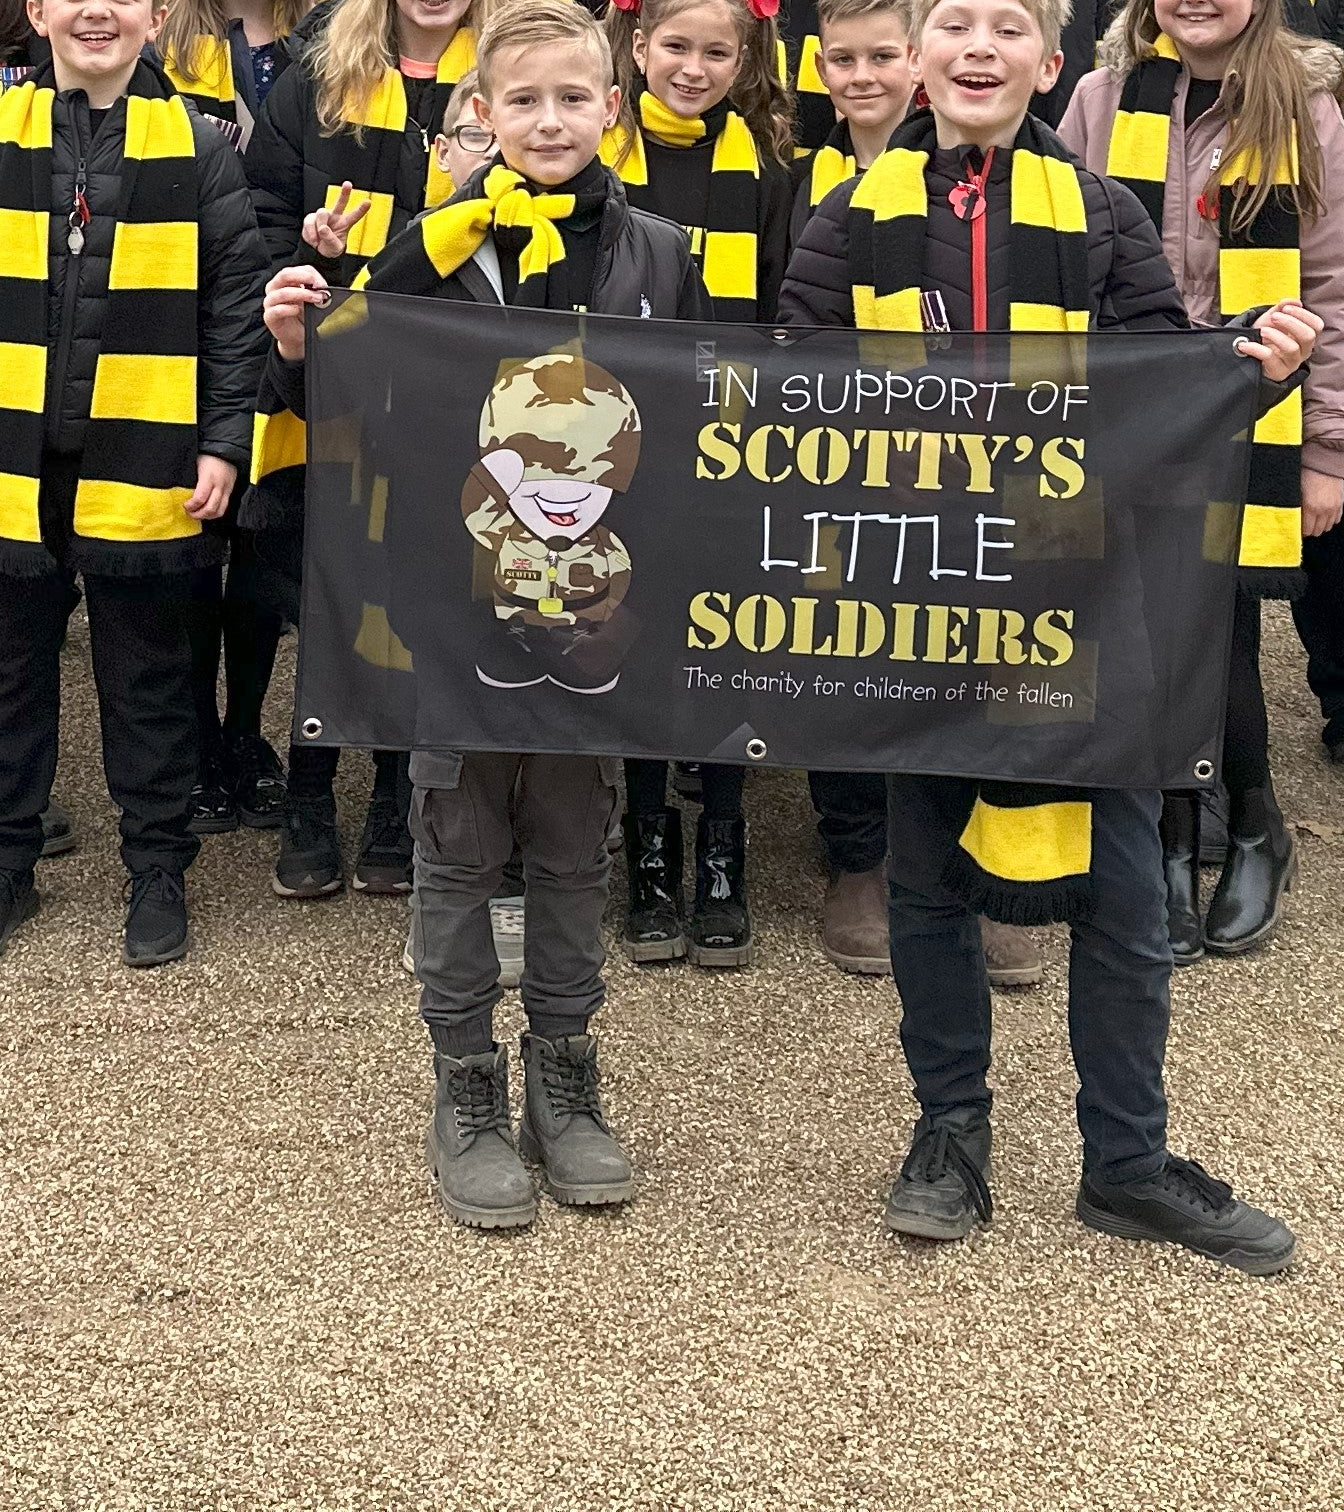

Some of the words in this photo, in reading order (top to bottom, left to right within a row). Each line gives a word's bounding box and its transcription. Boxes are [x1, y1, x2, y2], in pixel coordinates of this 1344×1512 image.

[702, 365, 758, 408] IN
[781, 369, 1016, 422] SUPPORT
[1027, 380, 1090, 422] OF
[695, 421, 1086, 500] SCOTTY'S
[760, 506, 1016, 584] LITTLE
[687, 591, 1074, 667] SOLDIERS
[683, 666, 723, 690] The
[731, 670, 805, 699] charity
[813, 675, 846, 697] for
[853, 676, 937, 702] children
[945, 681, 968, 702] of
[974, 681, 1009, 703] the
[1016, 681, 1074, 708] fallen
